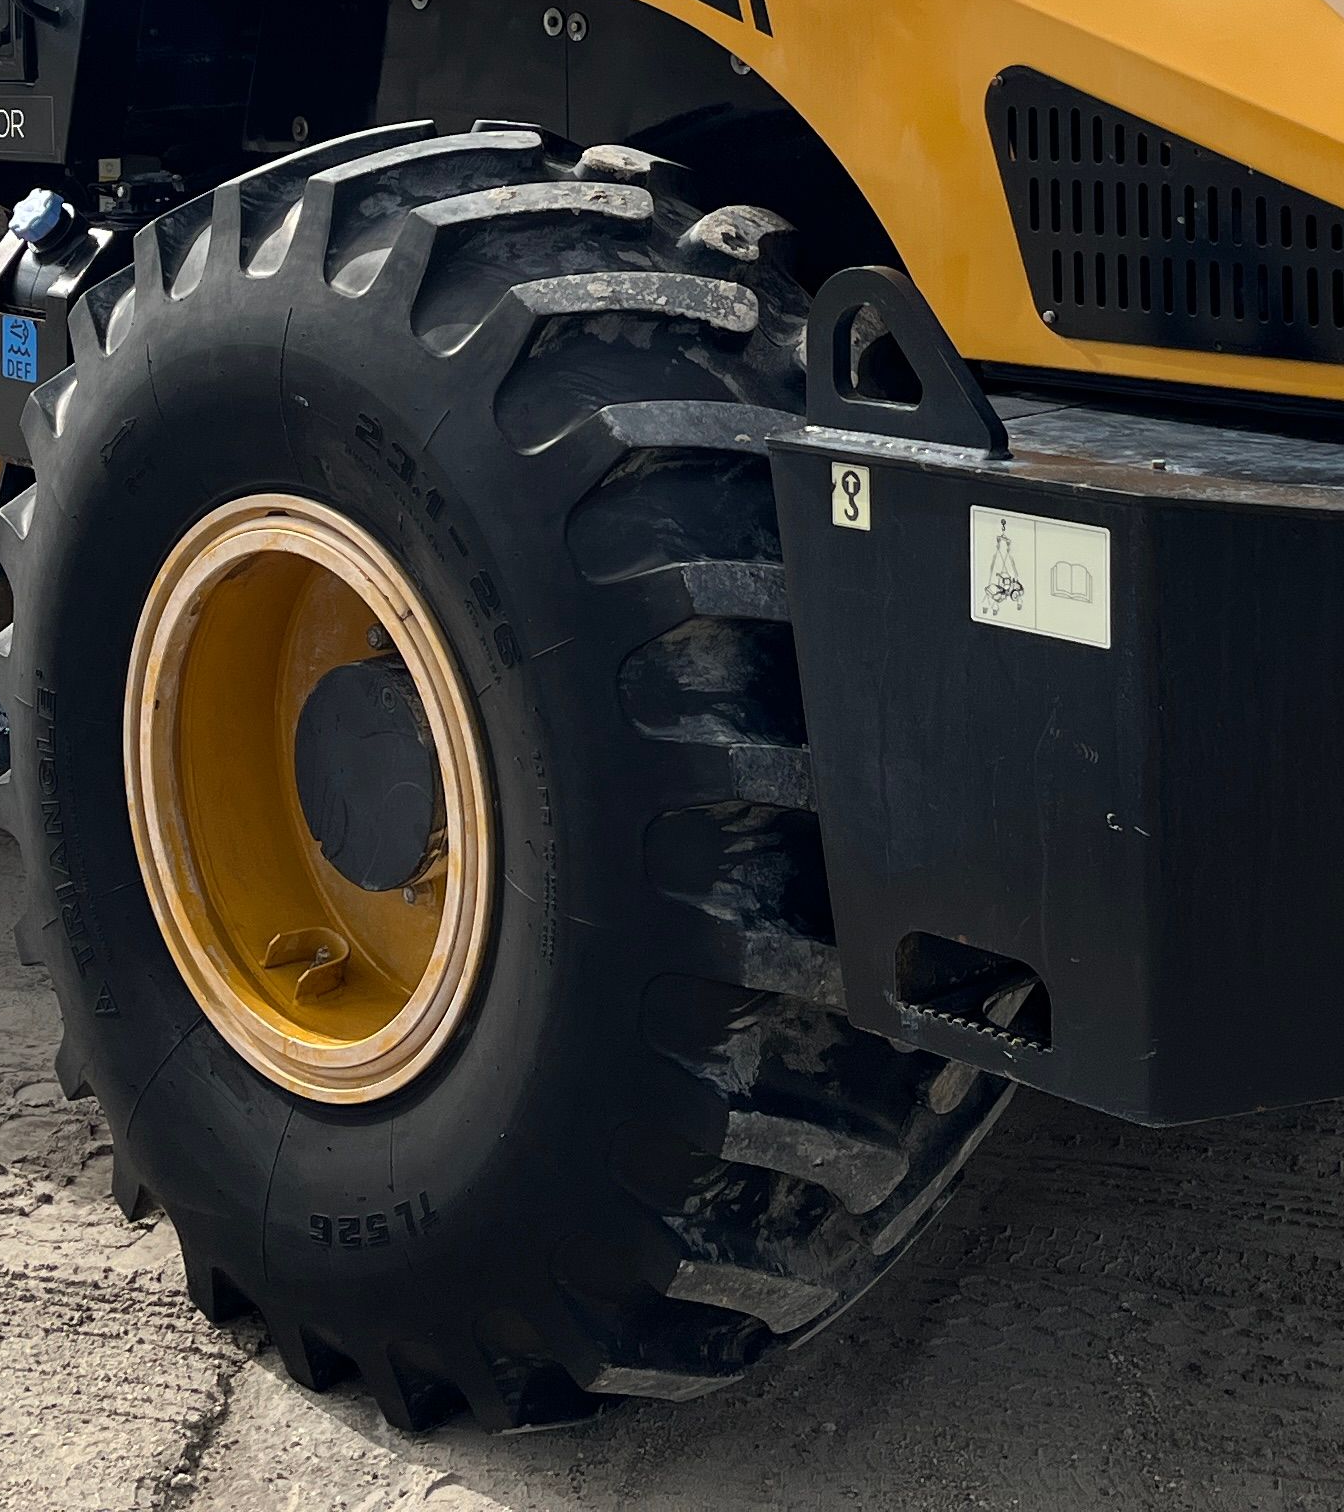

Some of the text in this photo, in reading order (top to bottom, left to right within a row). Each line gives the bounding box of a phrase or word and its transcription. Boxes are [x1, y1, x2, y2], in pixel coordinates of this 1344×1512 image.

[7, 358, 32, 380] DEF
[36, 685, 97, 978] TRIANGLE
[308, 1190, 440, 1248] TL526
